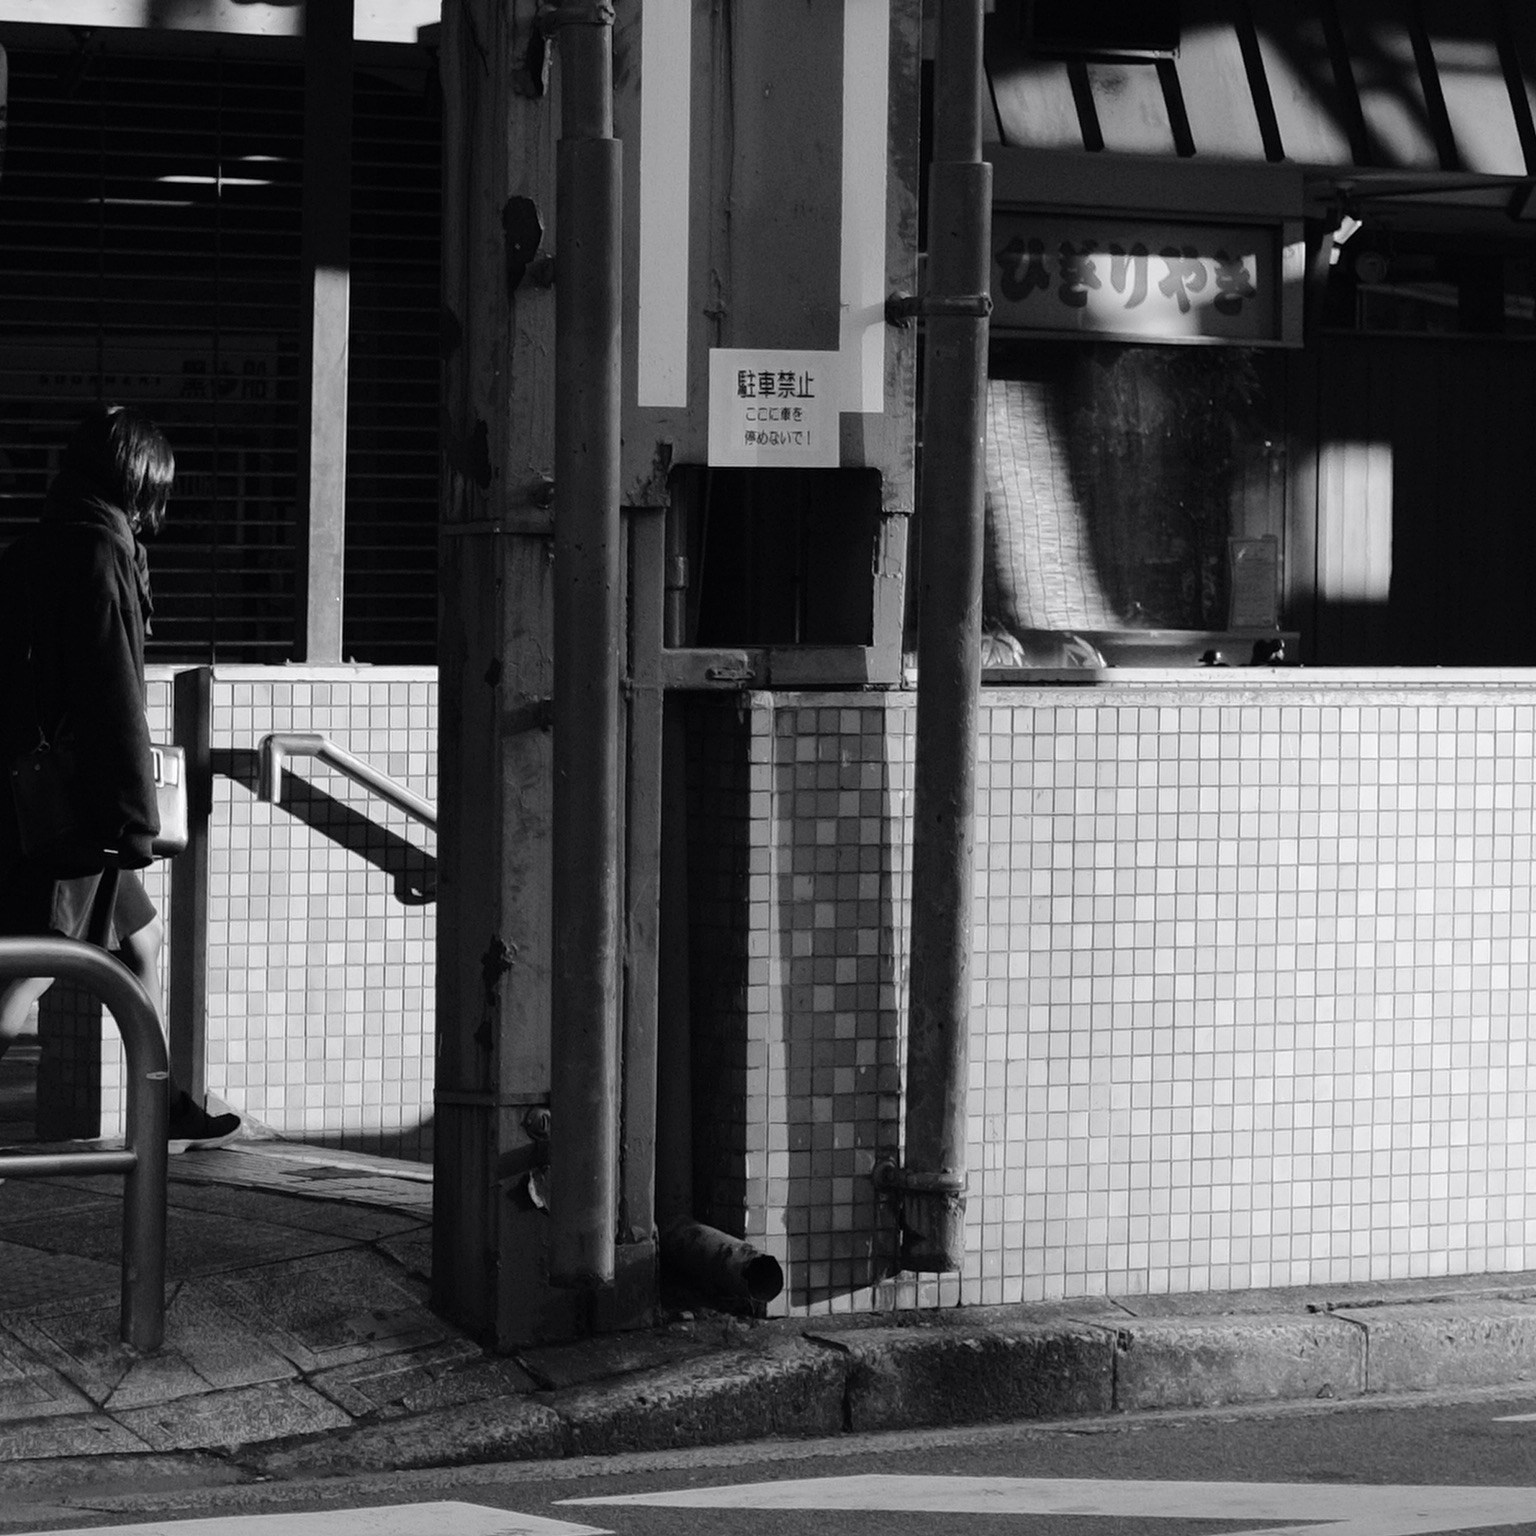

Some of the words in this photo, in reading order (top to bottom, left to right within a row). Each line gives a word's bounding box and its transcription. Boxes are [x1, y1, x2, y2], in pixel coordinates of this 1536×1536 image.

[994, 236, 1258, 316] ひぎりやき
[737, 369, 816, 399] 駐車禁止
